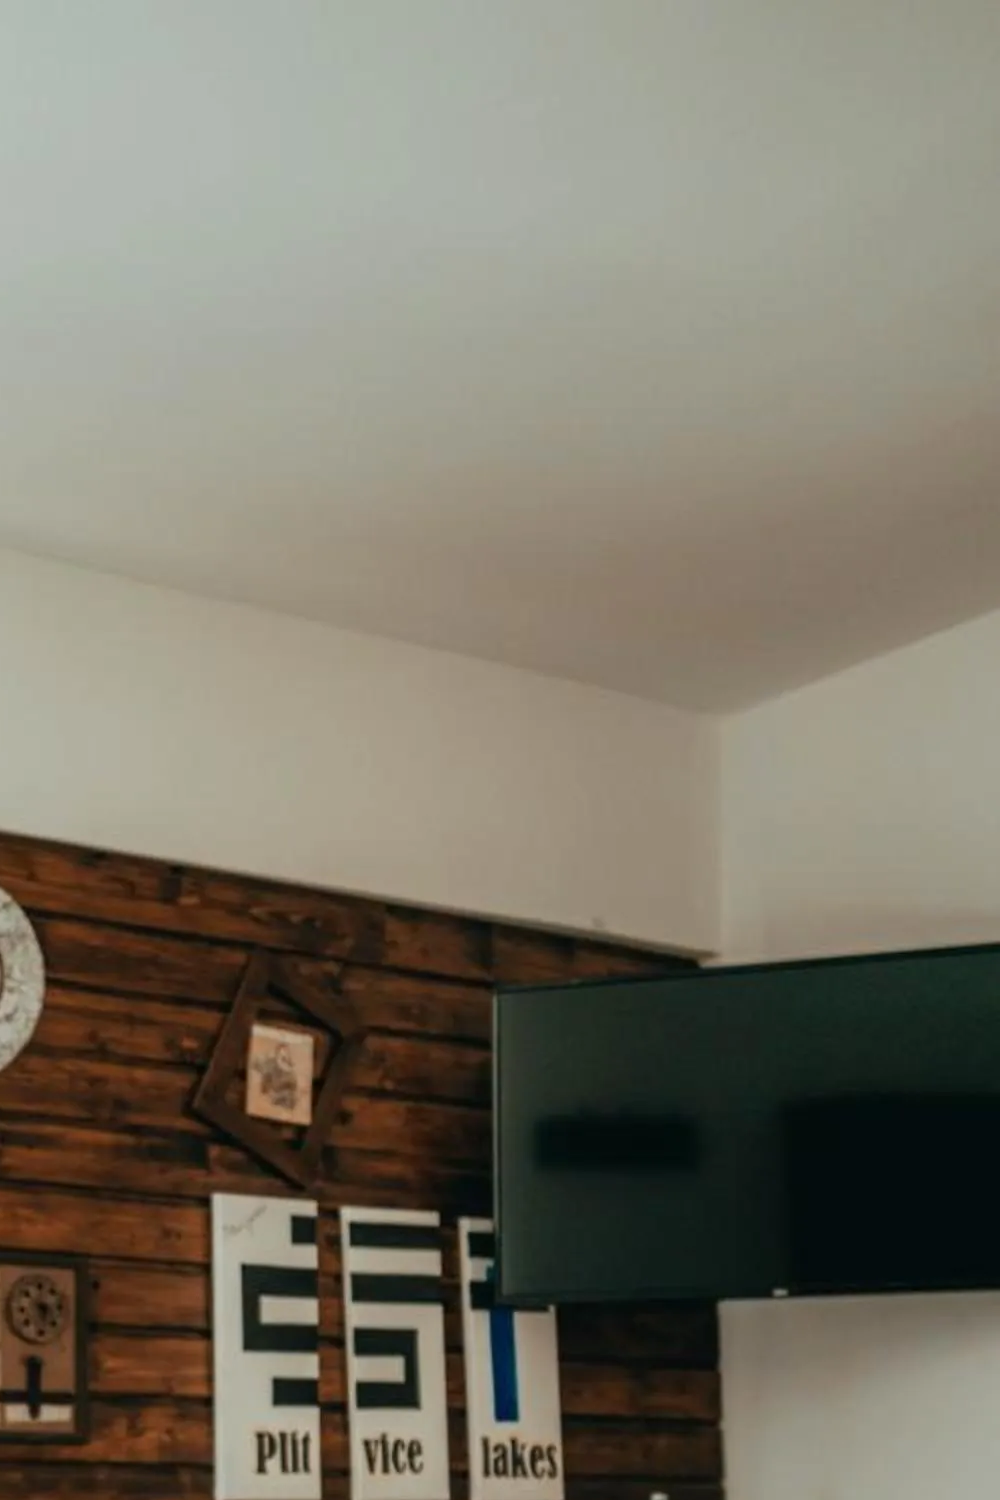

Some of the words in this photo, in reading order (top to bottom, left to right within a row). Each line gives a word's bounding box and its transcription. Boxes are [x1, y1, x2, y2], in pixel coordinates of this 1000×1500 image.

[254, 1429, 312, 1475] Plit
[362, 1433, 425, 1476] vice
[481, 1436, 558, 1480] lakes
